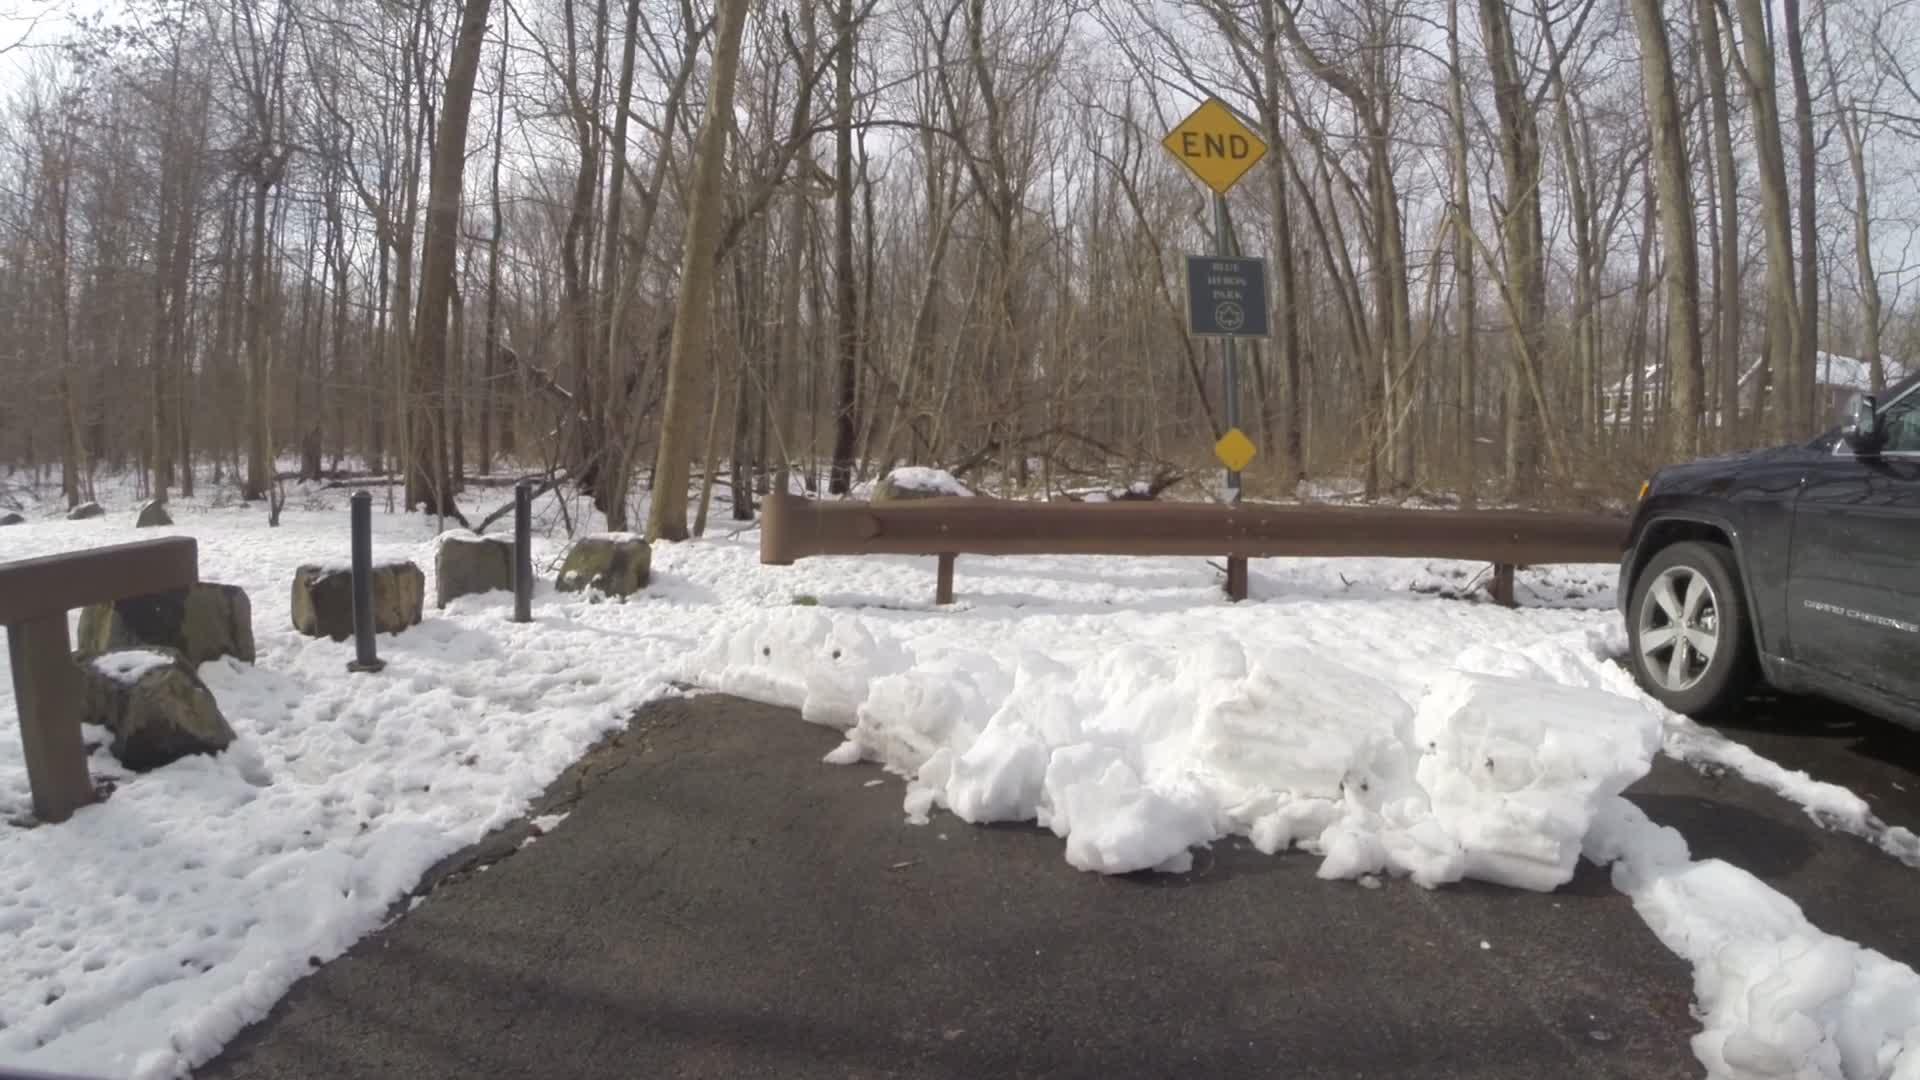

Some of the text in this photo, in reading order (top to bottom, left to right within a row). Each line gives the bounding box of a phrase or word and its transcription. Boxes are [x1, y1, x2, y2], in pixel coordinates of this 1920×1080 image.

[1182, 132, 1249, 159] END
[1212, 290, 1243, 301] PARK
[1803, 600, 1919, 633] GRAND CHEROKEE
